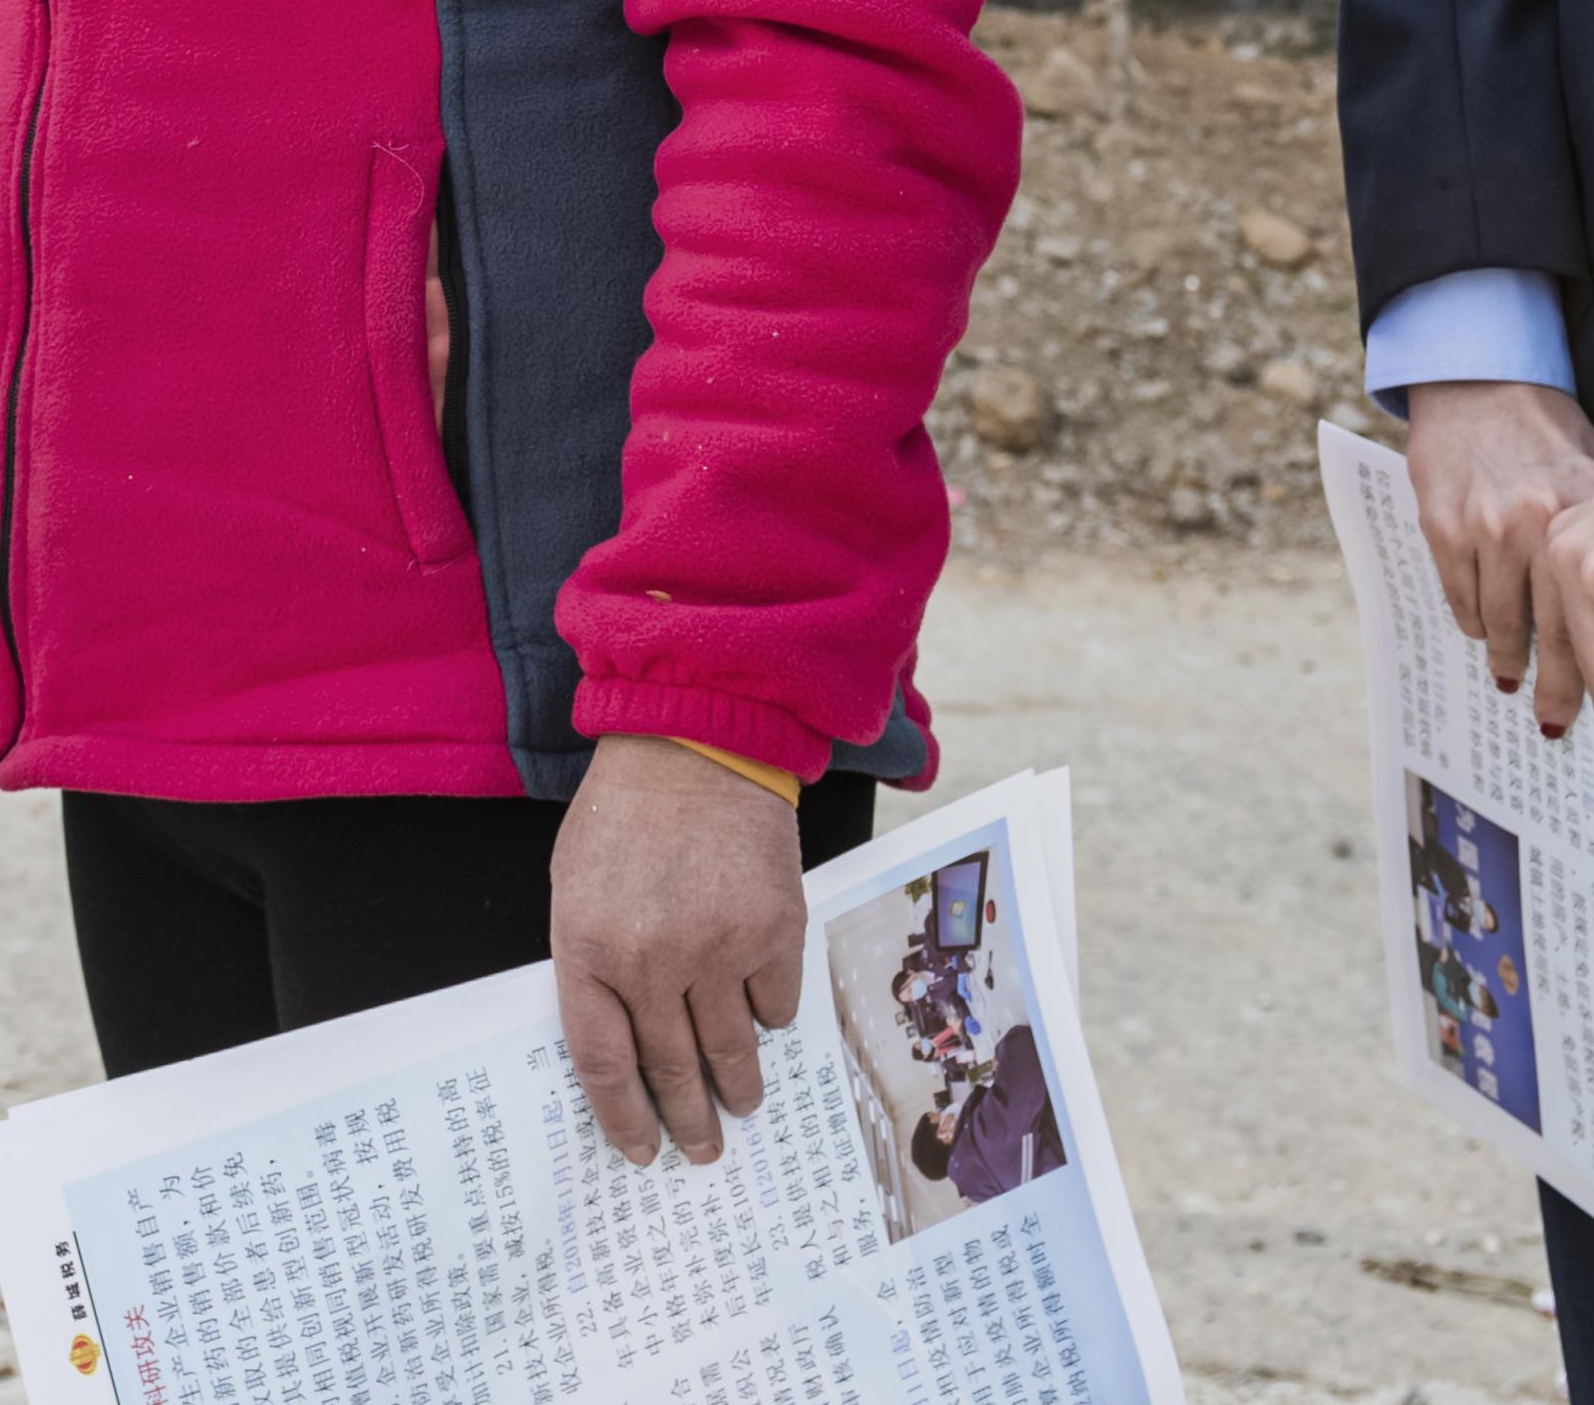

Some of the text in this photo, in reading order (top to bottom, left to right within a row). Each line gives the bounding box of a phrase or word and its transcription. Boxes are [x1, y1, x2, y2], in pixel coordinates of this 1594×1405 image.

[54, 1241, 88, 1321] 薛城税务
[535, 1238, 582, 1395] 收企业所得税。
